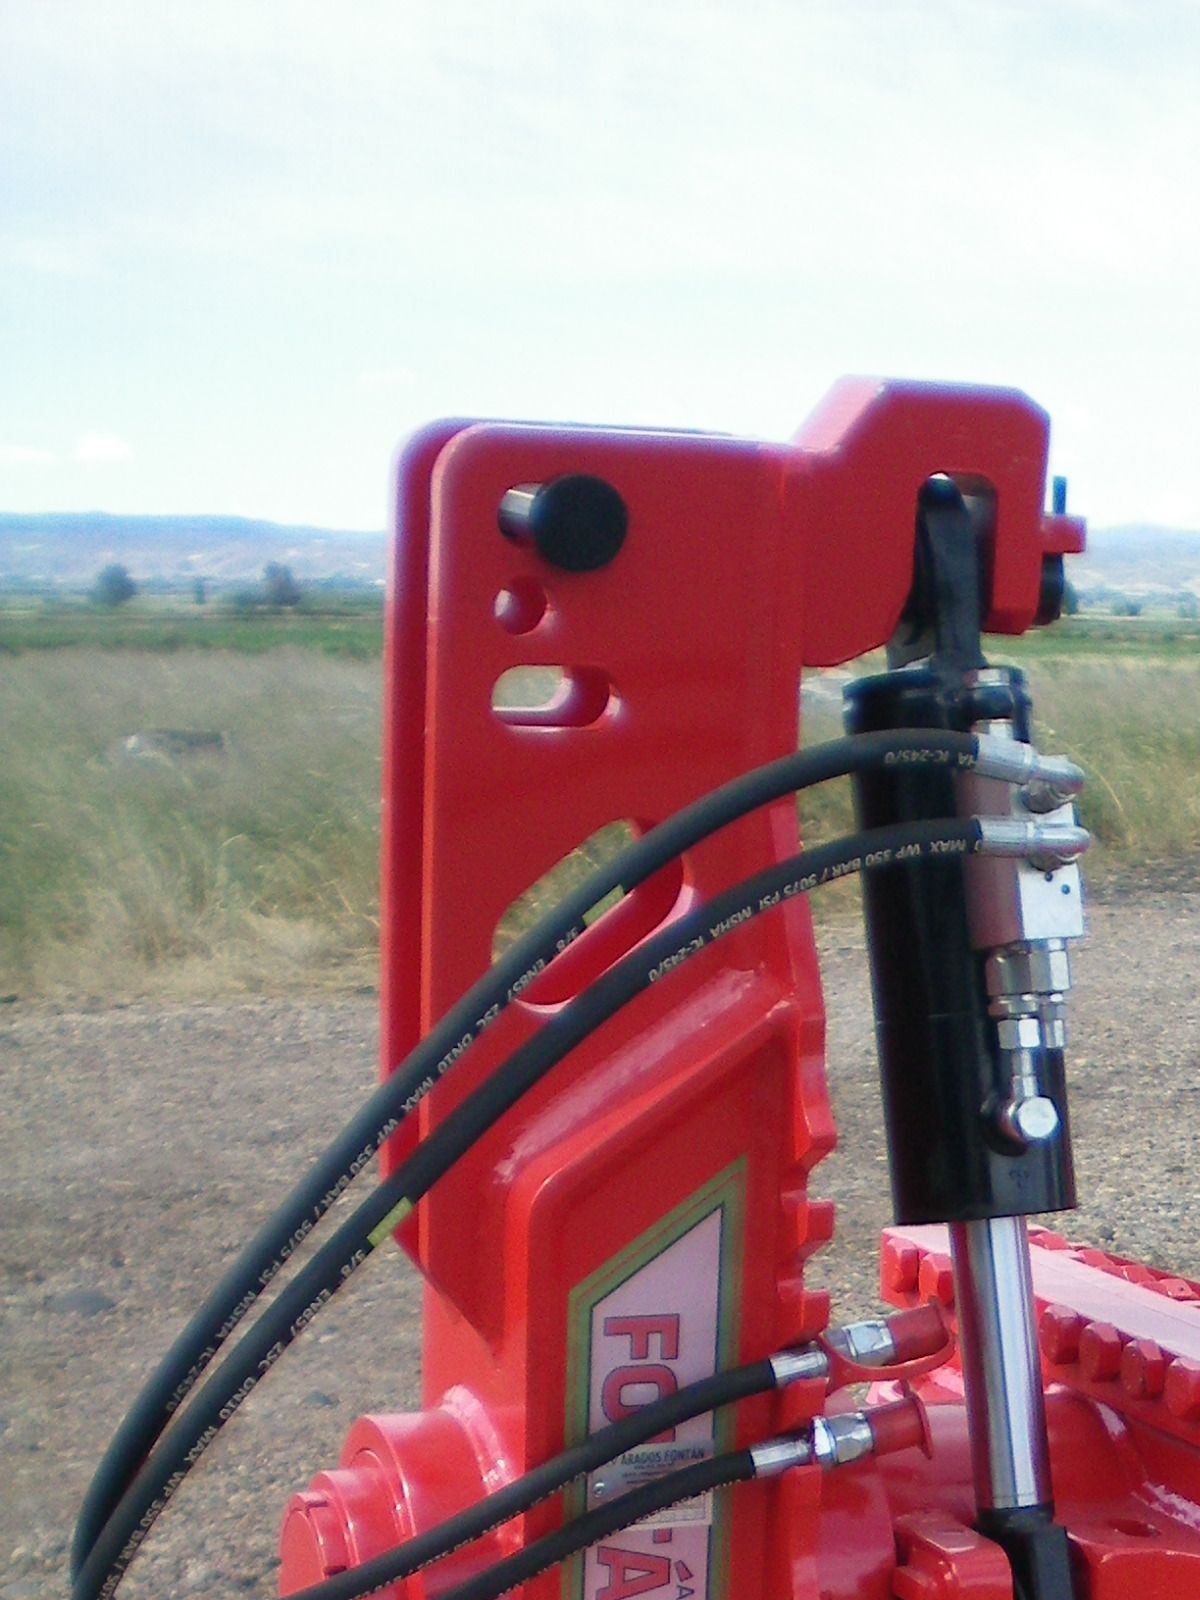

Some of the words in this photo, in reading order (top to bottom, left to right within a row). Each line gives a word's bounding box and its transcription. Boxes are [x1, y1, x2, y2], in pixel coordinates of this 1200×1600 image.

[896, 843, 920, 858] WP
[930, 839, 967, 853] MAX
[832, 857, 861, 876] BAR
[759, 890, 780, 910] PSI
[709, 905, 752, 938] MSHA
[400, 1076, 434, 1112] MAX
[183, 1425, 218, 1463] MAX
[163, 1471, 187, 1498] WP
